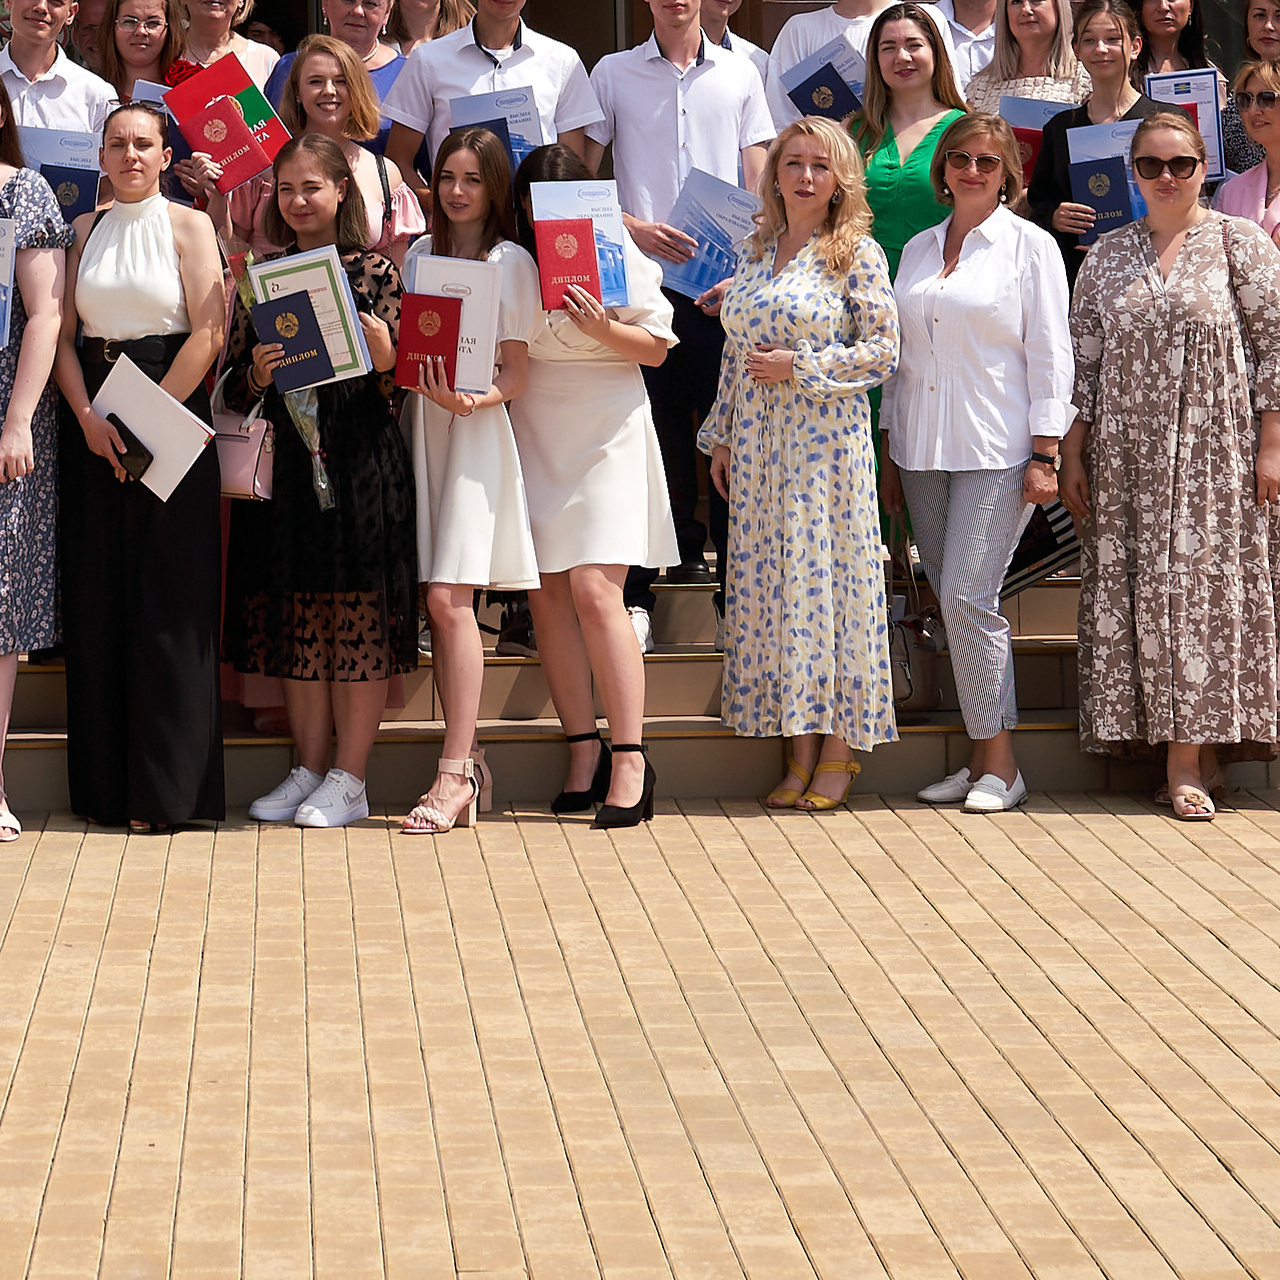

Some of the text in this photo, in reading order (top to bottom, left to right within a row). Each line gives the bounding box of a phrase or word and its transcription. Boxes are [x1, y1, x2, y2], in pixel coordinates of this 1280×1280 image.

[219, 144, 251, 167] ИПЛОМ
[551, 274, 591, 284] ДИПЛОМ
[279, 348, 319, 368] ДИПЛОМ
